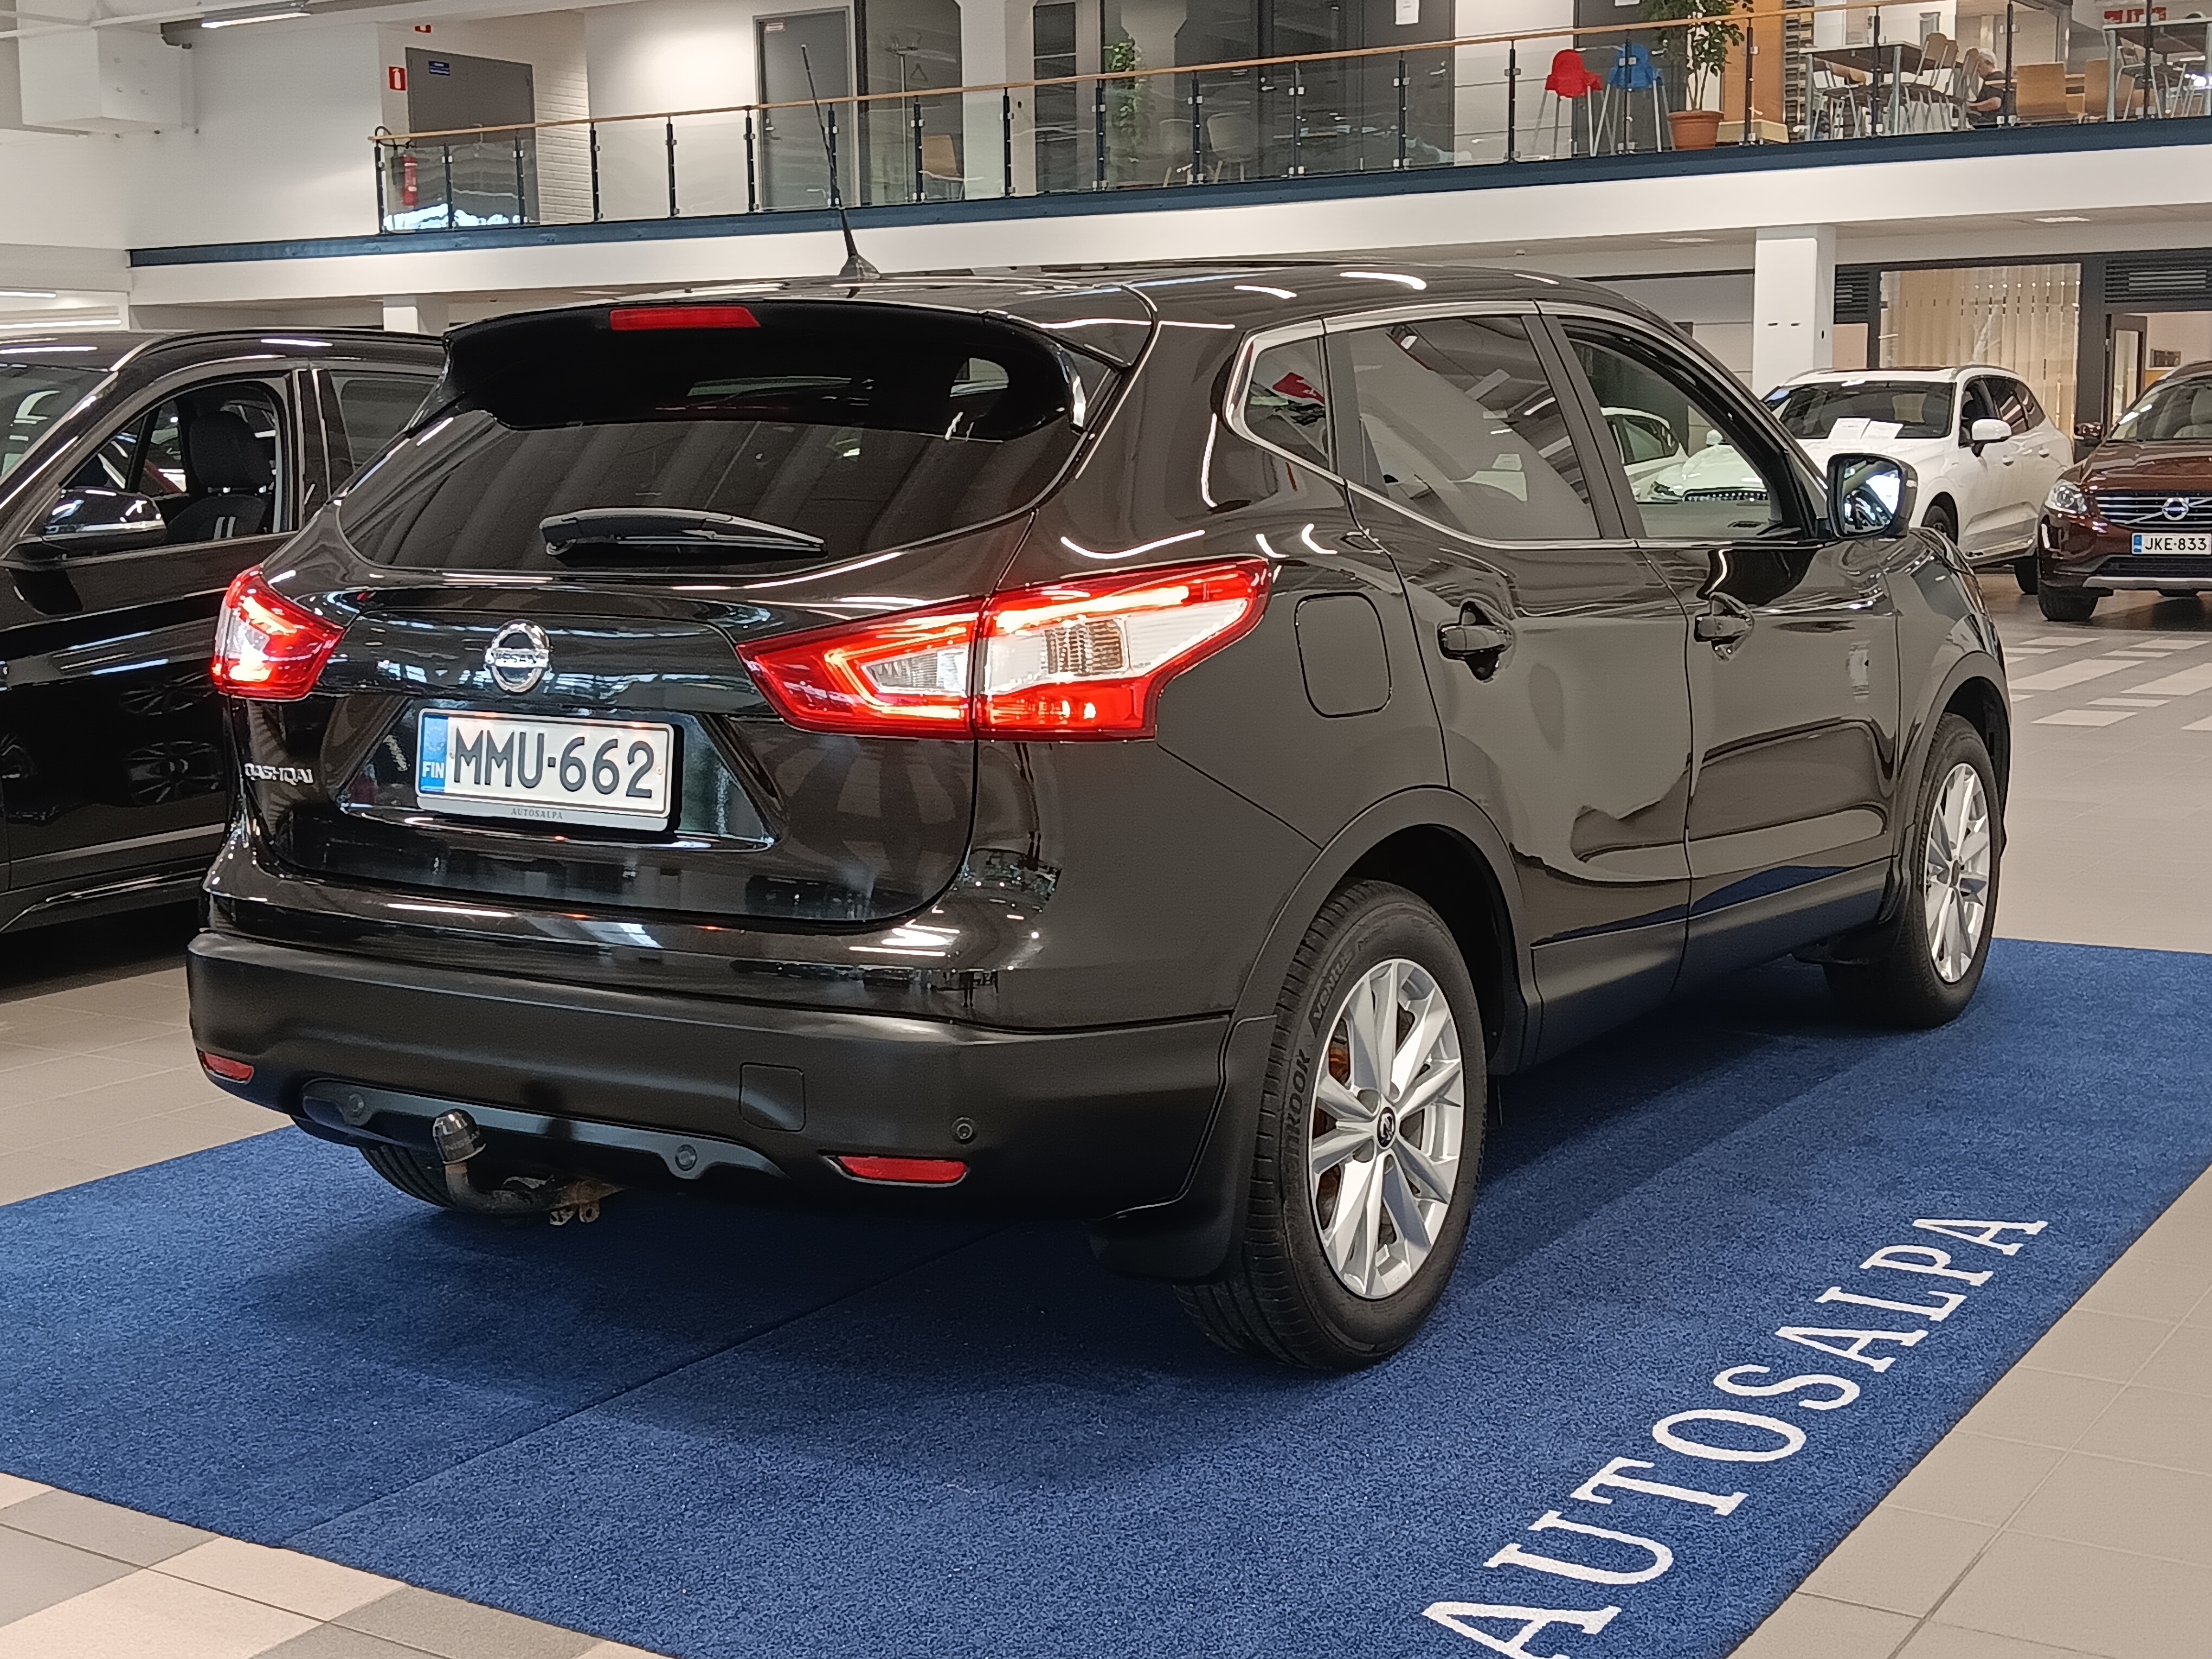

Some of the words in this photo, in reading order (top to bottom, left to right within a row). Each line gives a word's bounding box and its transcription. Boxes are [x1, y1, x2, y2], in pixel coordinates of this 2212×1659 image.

[422, 761, 445, 779] FIN
[511, 808, 563, 819] AUTOSALPA
[1421, 1217, 2048, 1659] AUTOSALPA
